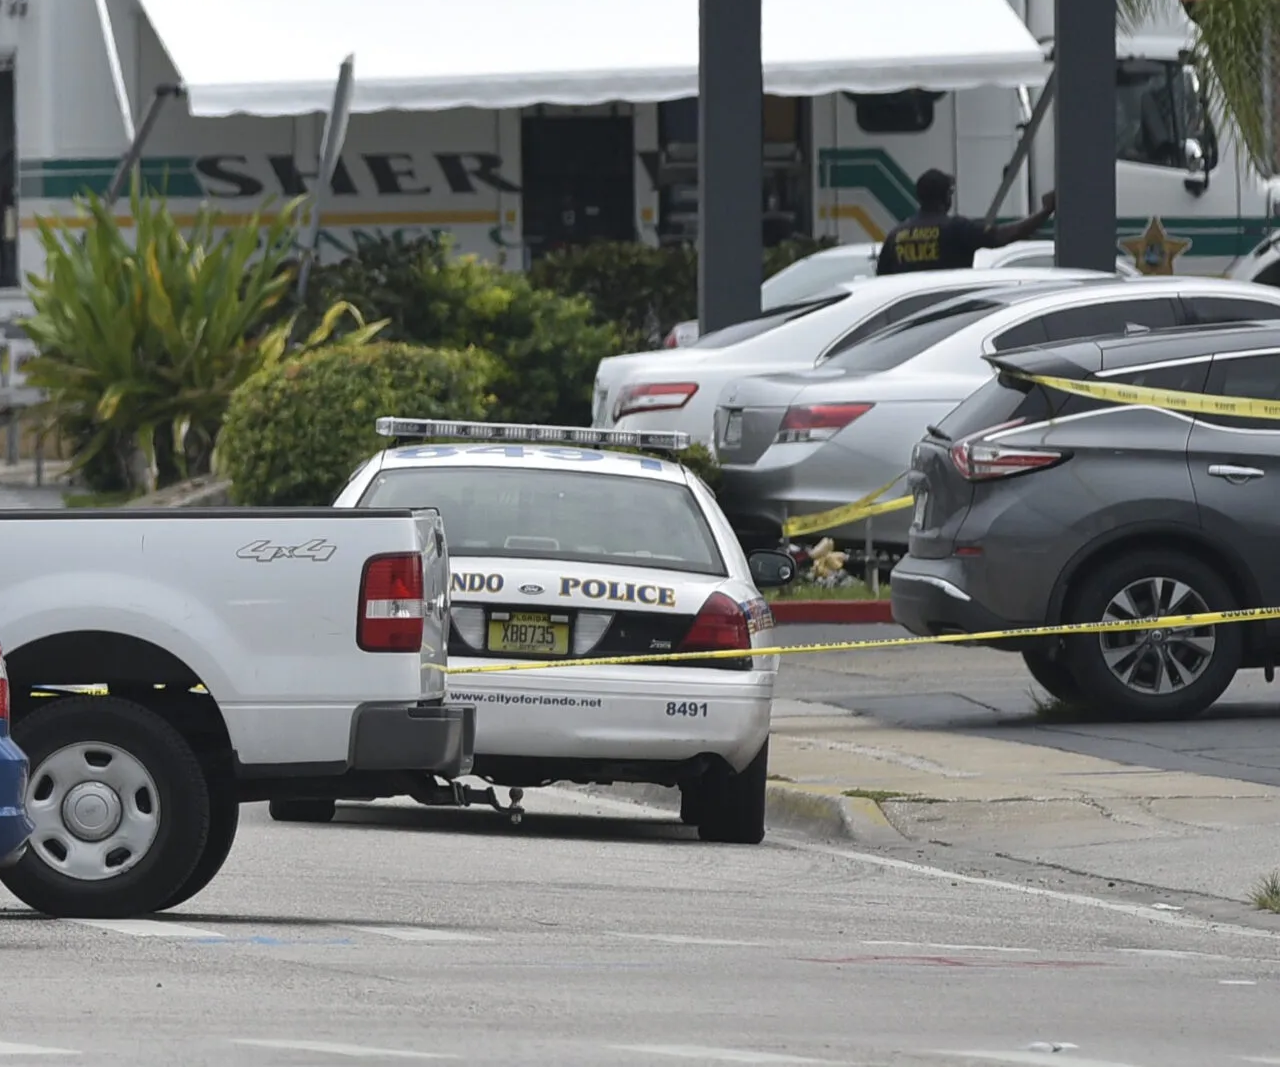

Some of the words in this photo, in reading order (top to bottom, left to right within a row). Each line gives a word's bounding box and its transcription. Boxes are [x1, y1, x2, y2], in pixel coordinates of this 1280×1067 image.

[236, 538, 338, 562] 4x4
[558, 576, 677, 608] POLICE
[502, 623, 555, 644] XB8735
[450, 691, 602, 708] www.cityoforlando.net
[666, 701, 709, 718] 8491
